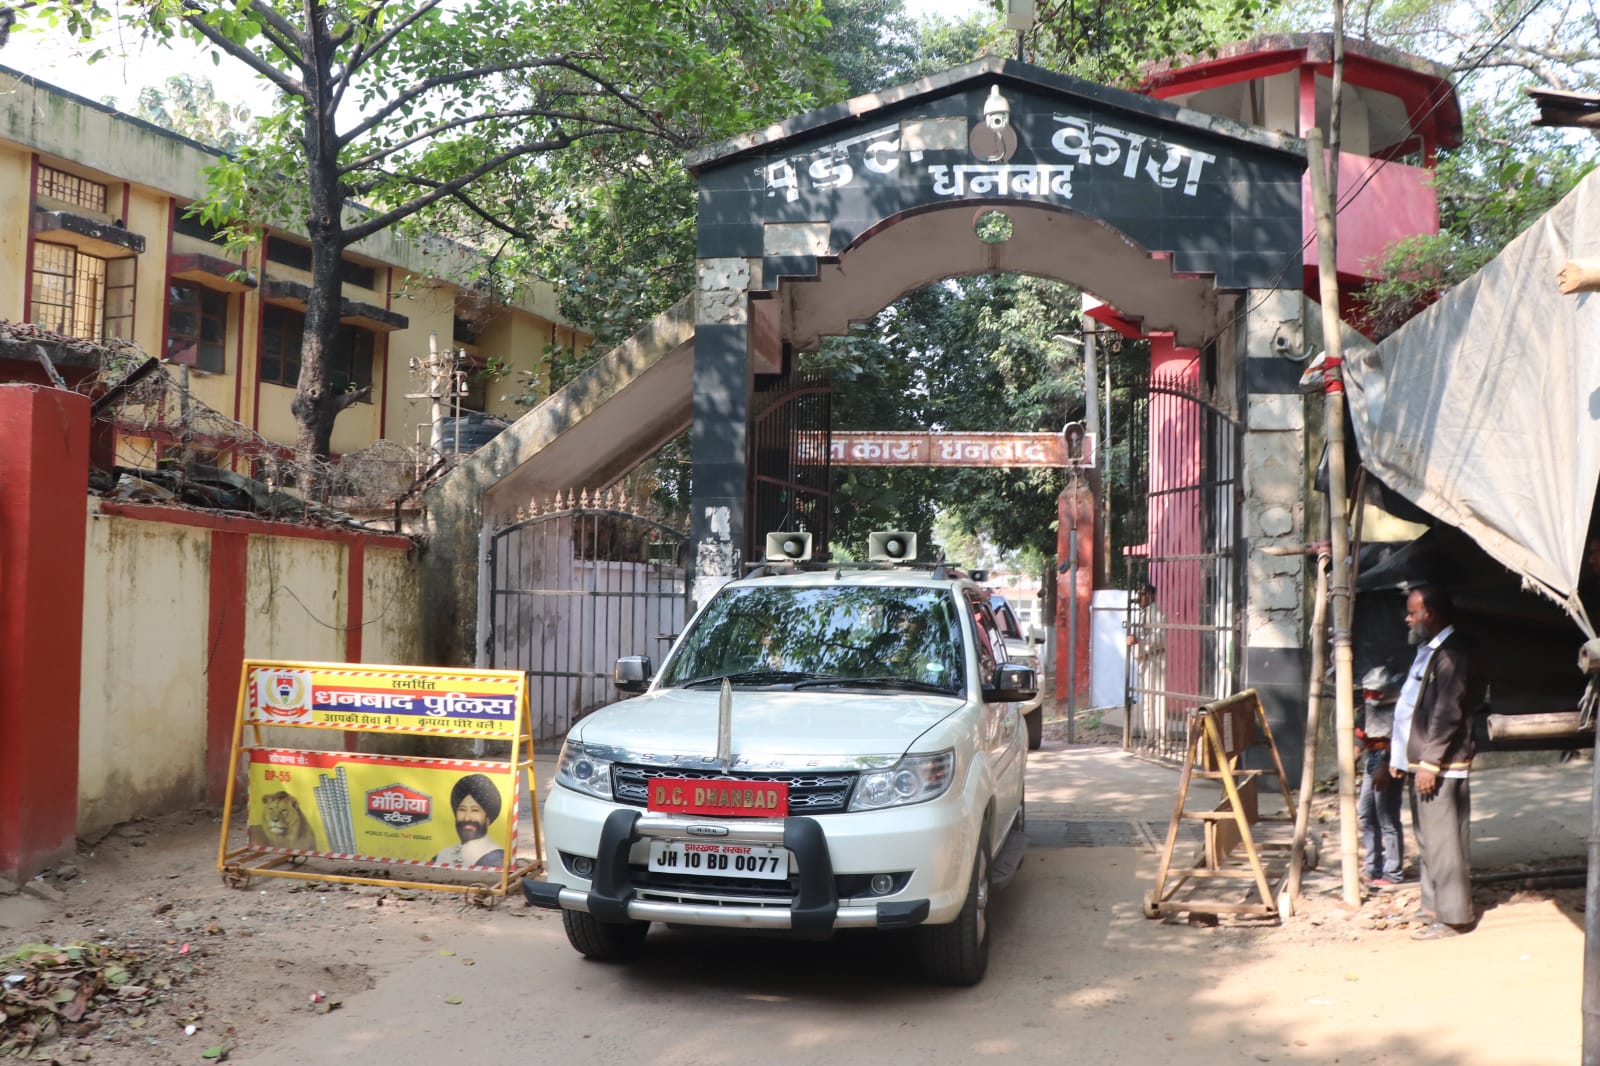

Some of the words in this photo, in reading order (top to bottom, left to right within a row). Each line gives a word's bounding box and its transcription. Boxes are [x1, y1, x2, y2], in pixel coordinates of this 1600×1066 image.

[928, 165, 1074, 199] धनबाद
[315, 691, 416, 710] धनबाद
[422, 692, 513, 717] पुलिस
[324, 713, 359, 723] आपकी
[655, 786, 689, 806] D.C.
[695, 787, 779, 809] DHANBAD
[383, 811, 413, 823] स्टील
[657, 850, 678, 867] JH
[684, 852, 701, 868] 10
[707, 853, 728, 870] BD
[735, 855, 780, 873] 0077
[722, 846, 752, 854] सरकार
